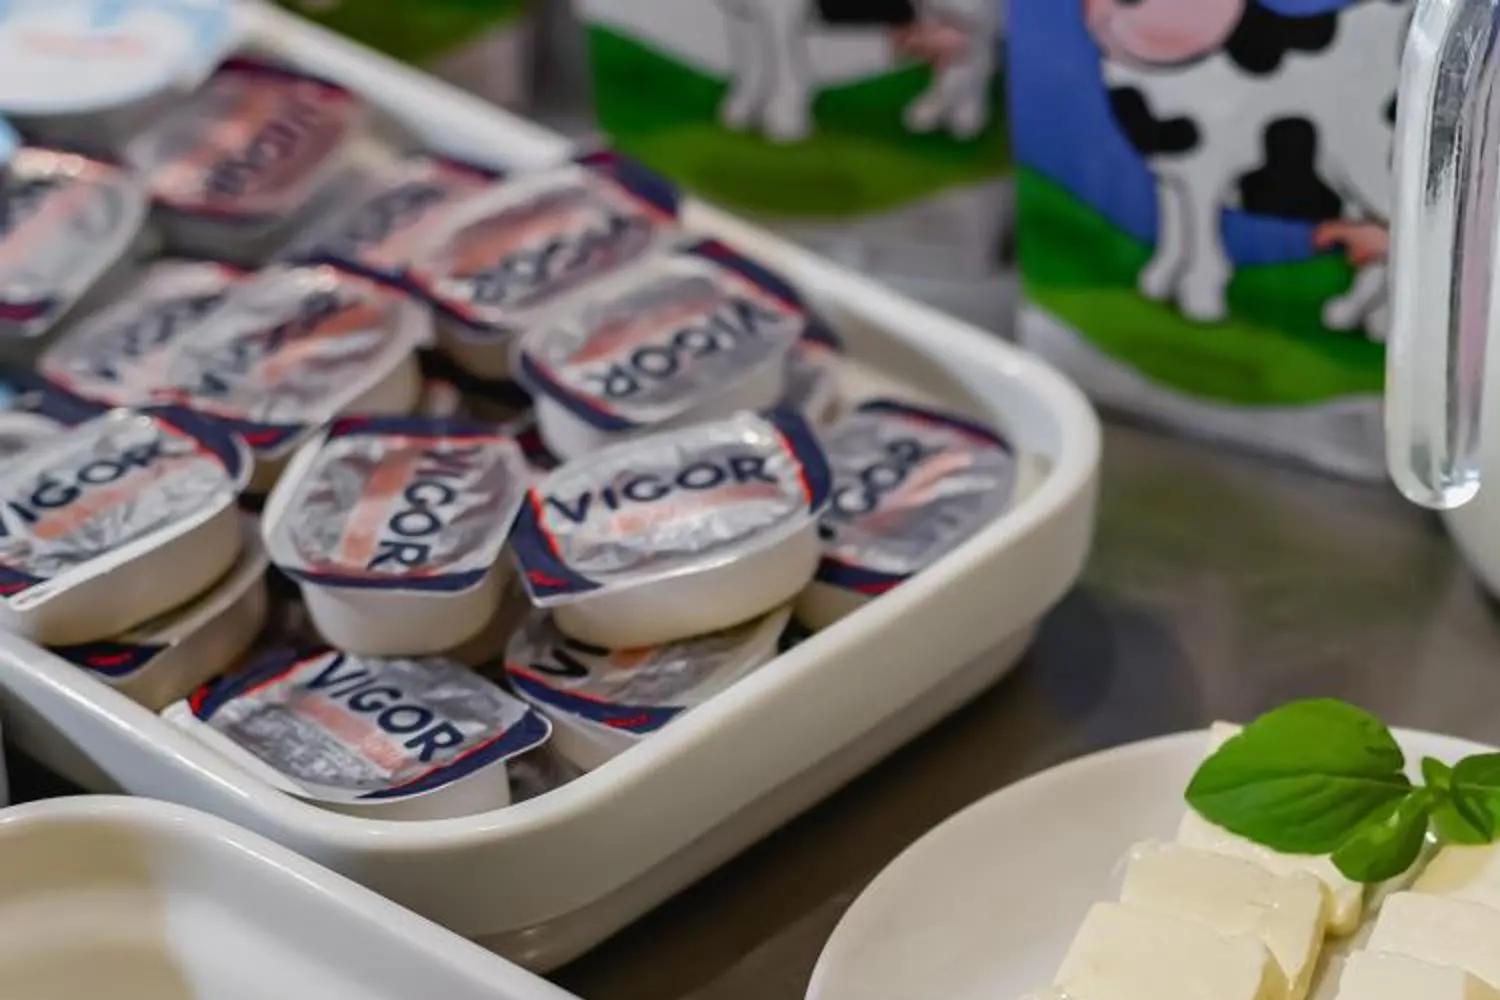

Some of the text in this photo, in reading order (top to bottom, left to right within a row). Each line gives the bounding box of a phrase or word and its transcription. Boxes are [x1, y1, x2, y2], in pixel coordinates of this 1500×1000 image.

[586, 300, 782, 398] VIGOR
[366, 446, 484, 571] VIGOR
[543, 456, 777, 524] VIGOR
[816, 438, 946, 542] GOR
[306, 652, 464, 762] VIGOR
